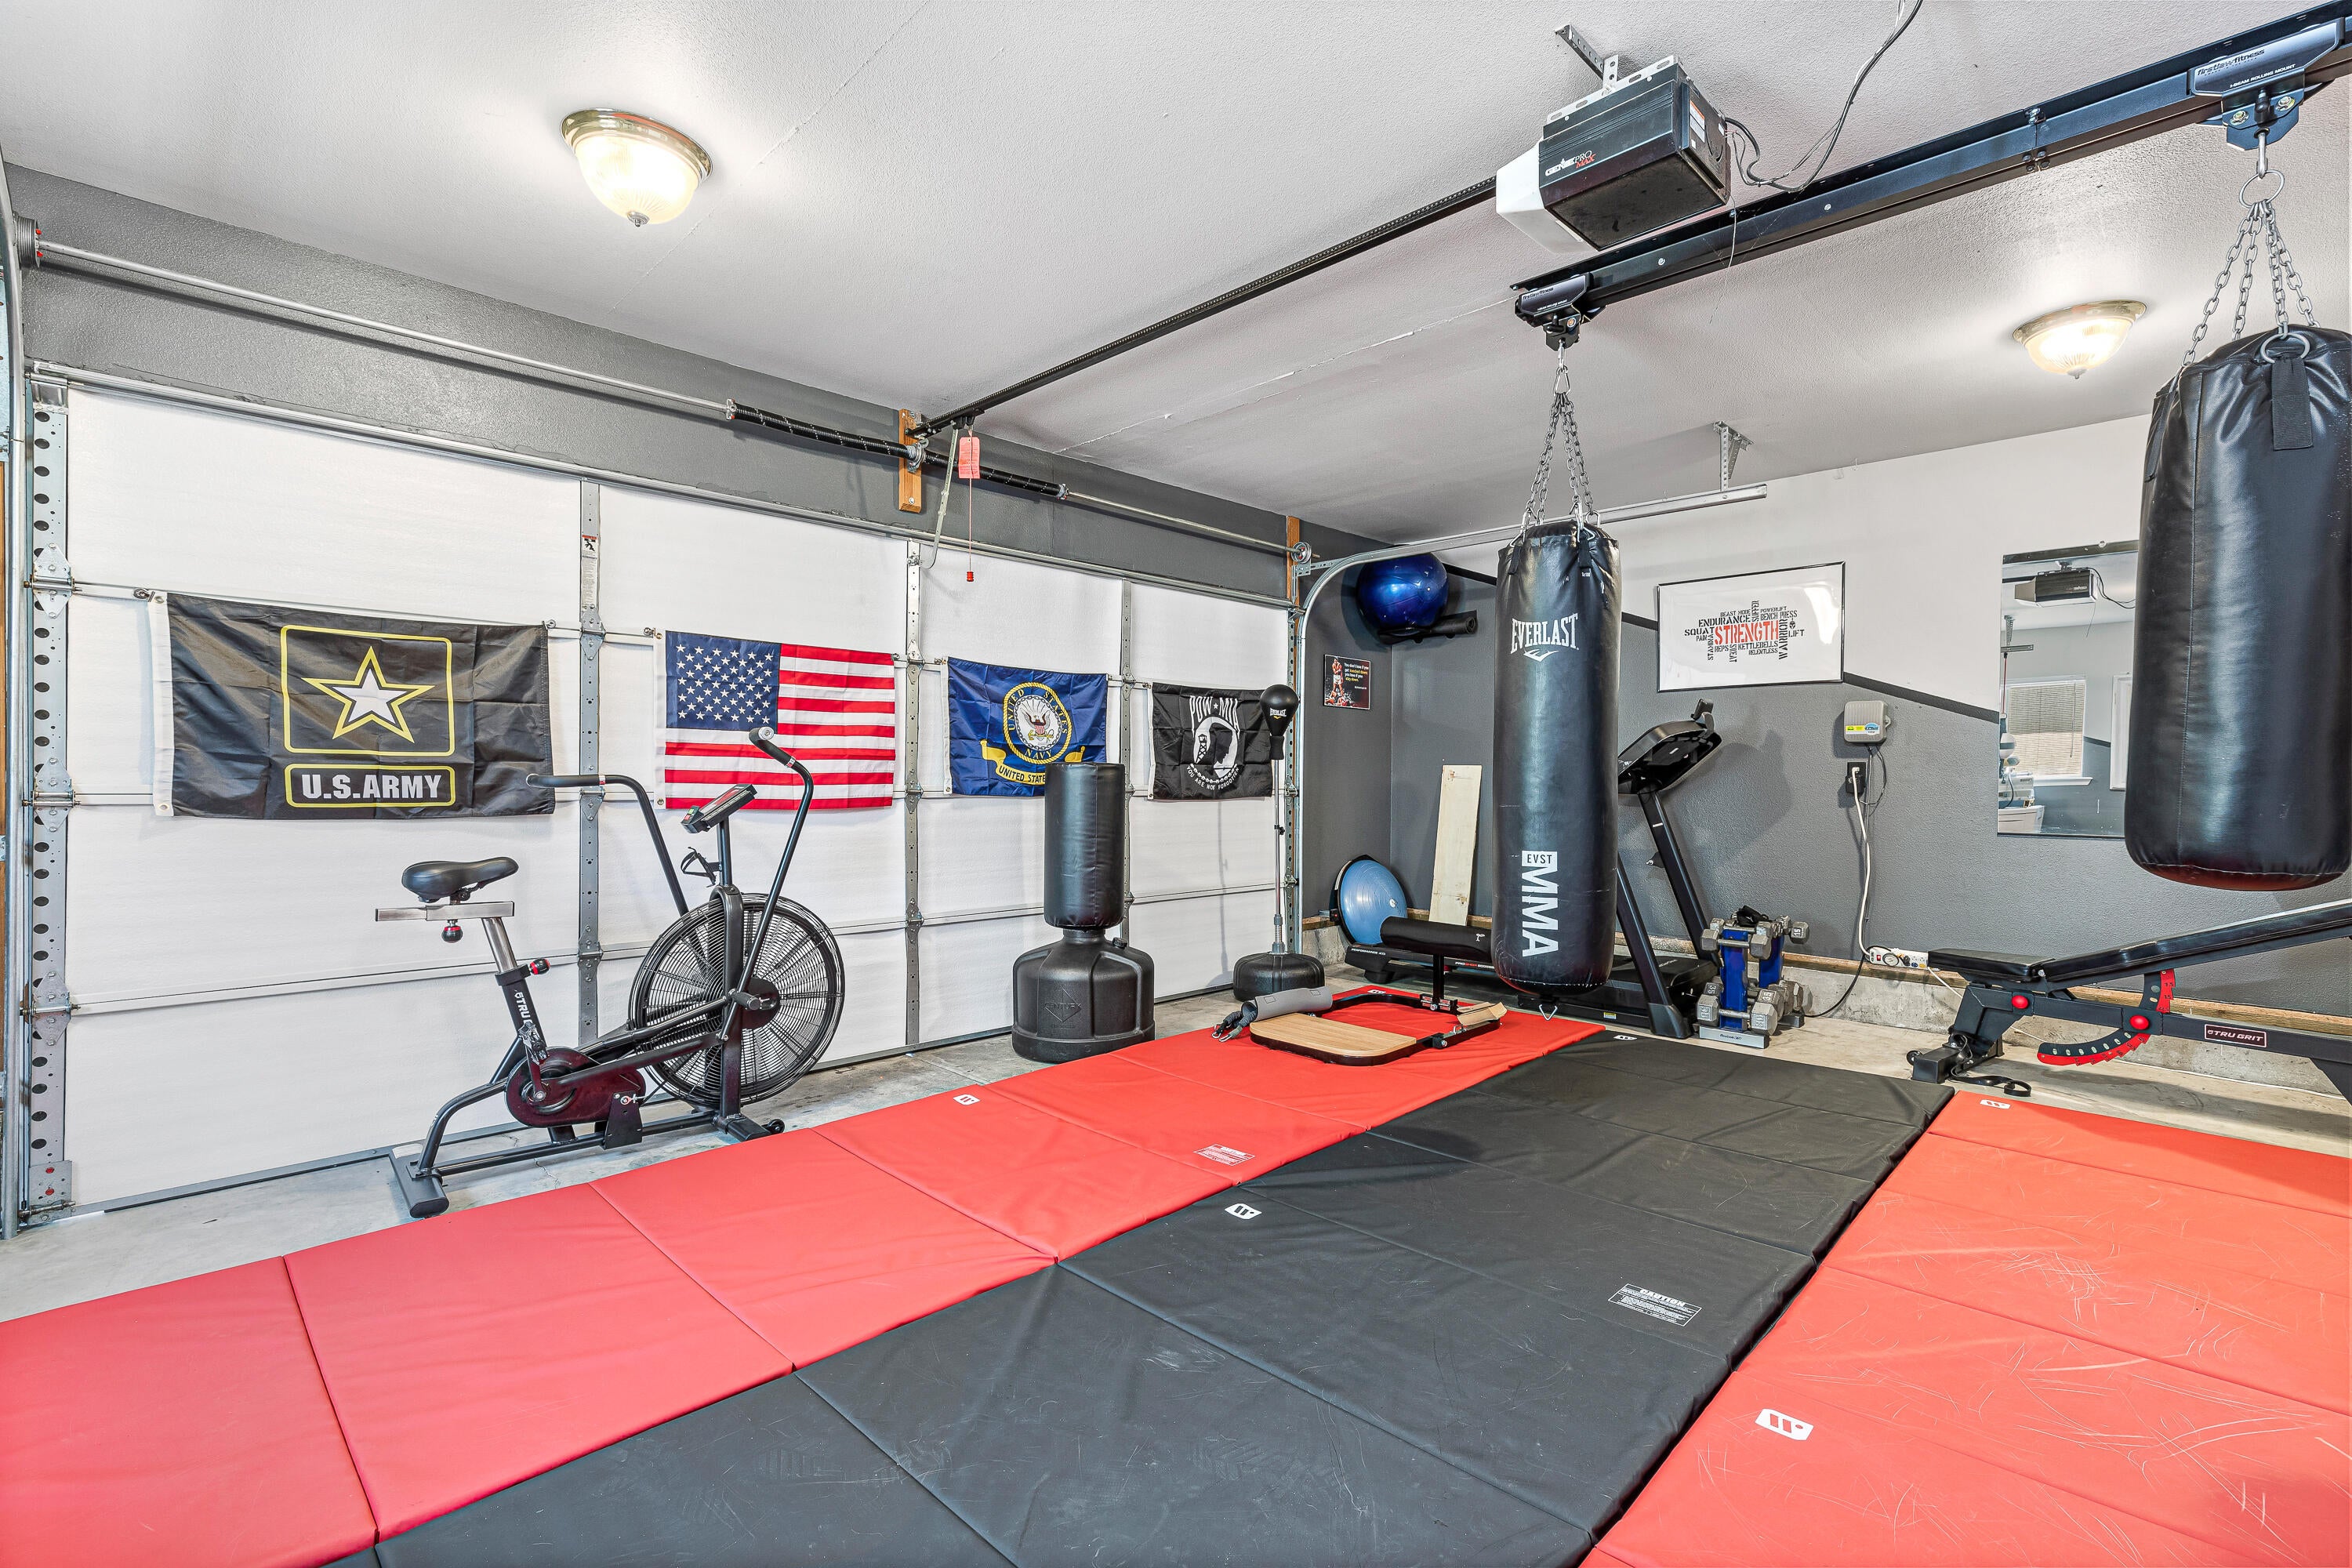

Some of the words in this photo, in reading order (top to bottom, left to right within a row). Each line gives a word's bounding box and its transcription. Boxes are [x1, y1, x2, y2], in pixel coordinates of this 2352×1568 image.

[2250, 71, 2274, 82] ROLLING
[2274, 64, 2296, 74] MOUNT
[1574, 150, 1592, 163] PRO
[1575, 154, 1596, 169] MAX
[1698, 615, 1751, 627] ENDURANCE
[1760, 612, 1778, 621] BENCH
[1780, 610, 1798, 619] PRESS
[1510, 612, 1578, 655] EVERLAST
[1684, 626, 1715, 636] SQUAT
[1715, 620, 1778, 645] STRENGTH
[1788, 629, 1805, 637] LIFT
[1738, 641, 1778, 650] KETTLEBELLS
[1779, 619, 1788, 659] WARRIOR
[1007, 688, 1025, 731] UNITED
[1044, 690, 1068, 734] STATES
[1189, 695, 1214, 739] POW
[1218, 696, 1241, 740] MIA
[1025, 748, 1052, 760] NAVY
[999, 765, 1025, 782] UNITED
[1028, 774, 1046, 782] STATE
[1186, 765, 1195, 778] YOU
[1194, 776, 1205, 787] ARE
[1218, 767, 1240, 790] FORGOTTEN
[1526, 854, 1552, 864] EVST
[1521, 851, 1559, 957] MMA
[1793, 928, 1801, 937] 15
[2236, 1033, 2264, 1042] GRIT
[1639, 1288, 1686, 1307] CAUTION
